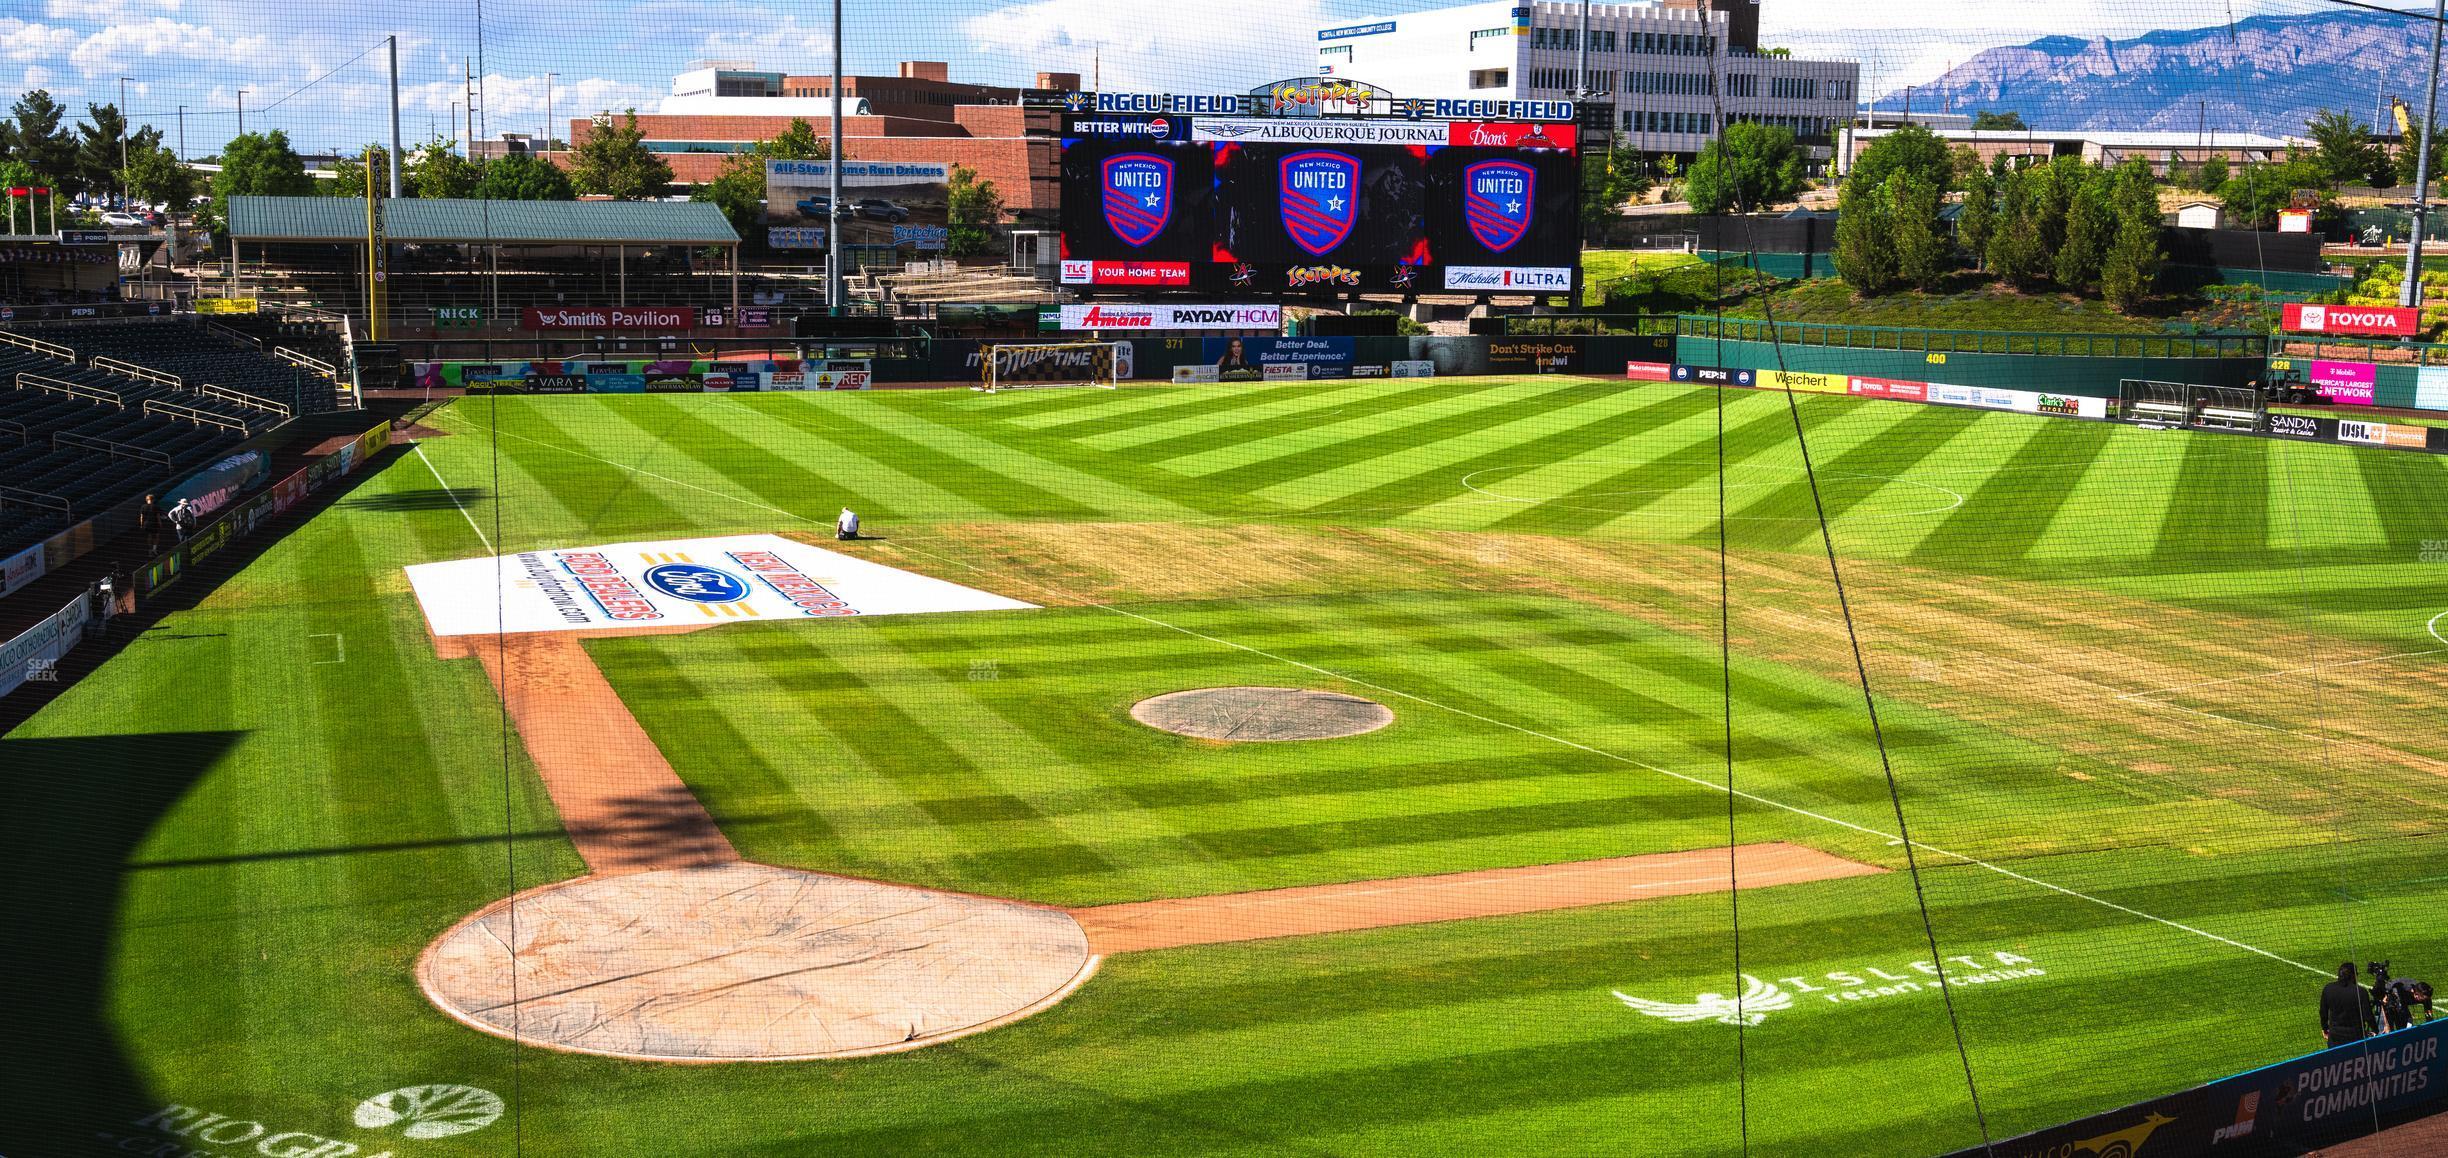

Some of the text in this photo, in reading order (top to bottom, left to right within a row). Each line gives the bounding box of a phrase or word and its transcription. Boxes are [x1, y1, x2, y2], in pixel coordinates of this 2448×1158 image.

[1098, 93, 1238, 114] RGCU FIELD
[1271, 81, 1373, 111] ISOTOPES
[1436, 99, 1573, 119] RGCU FIELD
[1073, 121, 1151, 134] BETTER WITH
[1260, 126, 1447, 142] ALBUQUERQUE JOURNAL
[1469, 123, 1508, 146] Dion's
[774, 163, 826, 175] All-Star
[868, 165, 895, 176] Run
[895, 165, 945, 177] Drivers
[1114, 171, 1161, 188] UNITED
[1294, 171, 1346, 189] UNITED
[1477, 178, 1523, 194] UNITED
[85, 234, 107, 242] PORCH
[893, 224, 948, 244] Perfection
[1065, 264, 1087, 274] TLC
[1098, 268, 1186, 278] YOUR HOME TEAM
[1287, 264, 1362, 286] ISOTOPES
[1448, 271, 1565, 285] Michelob ULTRA
[71, 307, 96, 317] PEPSI
[440, 308, 479, 319] NICK
[558, 311, 680, 326] Smith's Pavilion
[1082, 306, 1153, 327] Amana
[1173, 309, 1278, 324] PAYDAY HCM
[704, 315, 724, 326] 19
[2329, 312, 2397, 328] TOYOTA
[1165, 338, 1184, 349] 371
[1275, 340, 1330, 349] Better Deal.
[1490, 343, 1577, 354] Don't Strike Out.
[1653, 338, 1668, 349] 428
[1054, 351, 1092, 367] TIME
[1260, 352, 1291, 361] Better
[1926, 353, 1946, 364] 400
[1264, 366, 1293, 374] FIESTA
[2271, 360, 2291, 370] 428
[539, 377, 574, 387] VARA
[772, 371, 805, 381] ESPN
[842, 373, 867, 385] RED
[1699, 369, 1727, 380] PEPSI
[1775, 372, 1828, 387] Weichert
[1862, 383, 1884, 391] TOYOTA
[2346, 380, 2374, 390] LARGEST
[2324, 387, 2374, 399] NETWORK
[2038, 393, 2080, 409] Clark's Pet
[2037, 405, 2080, 415] EMPORIUM
[2270, 415, 2317, 430] SANDIA
[2296, 429, 2315, 437] Casino
[2341, 422, 2370, 440] USL
[557, 552, 616, 575] FORD
[656, 570, 734, 595] Ford
[727, 551, 859, 618] NEW MEXICO
[1778, 951, 2034, 993] ISLETA
[1825, 965, 2047, 1004] resort casino
[2298, 1037, 2438, 1092] POWERING OUR
[2303, 1066, 2428, 1122] COMMUNITIES
[133, 1103, 265, 1145] RIO
[2211, 1118, 2256, 1146] PNM
